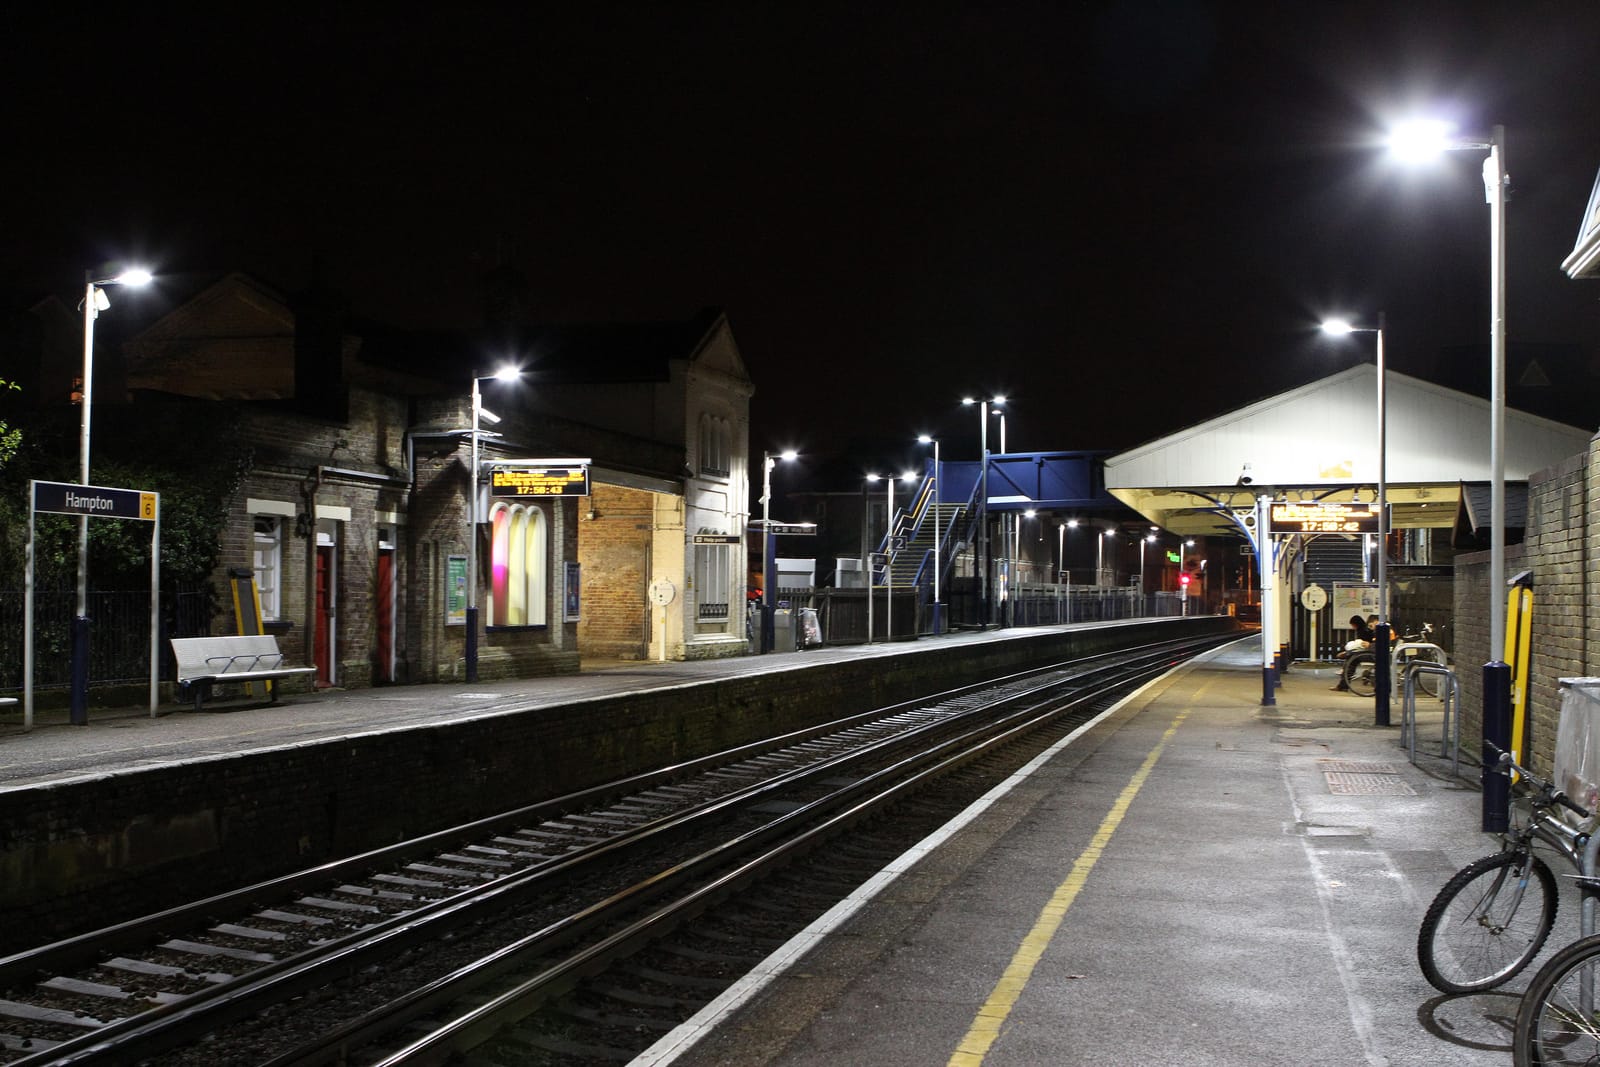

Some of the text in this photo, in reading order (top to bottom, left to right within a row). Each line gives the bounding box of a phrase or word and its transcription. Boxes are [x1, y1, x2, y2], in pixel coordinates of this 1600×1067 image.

[65, 491, 113, 512] Hampton
[145, 503, 151, 516] 6
[895, 537, 904, 549] 2
